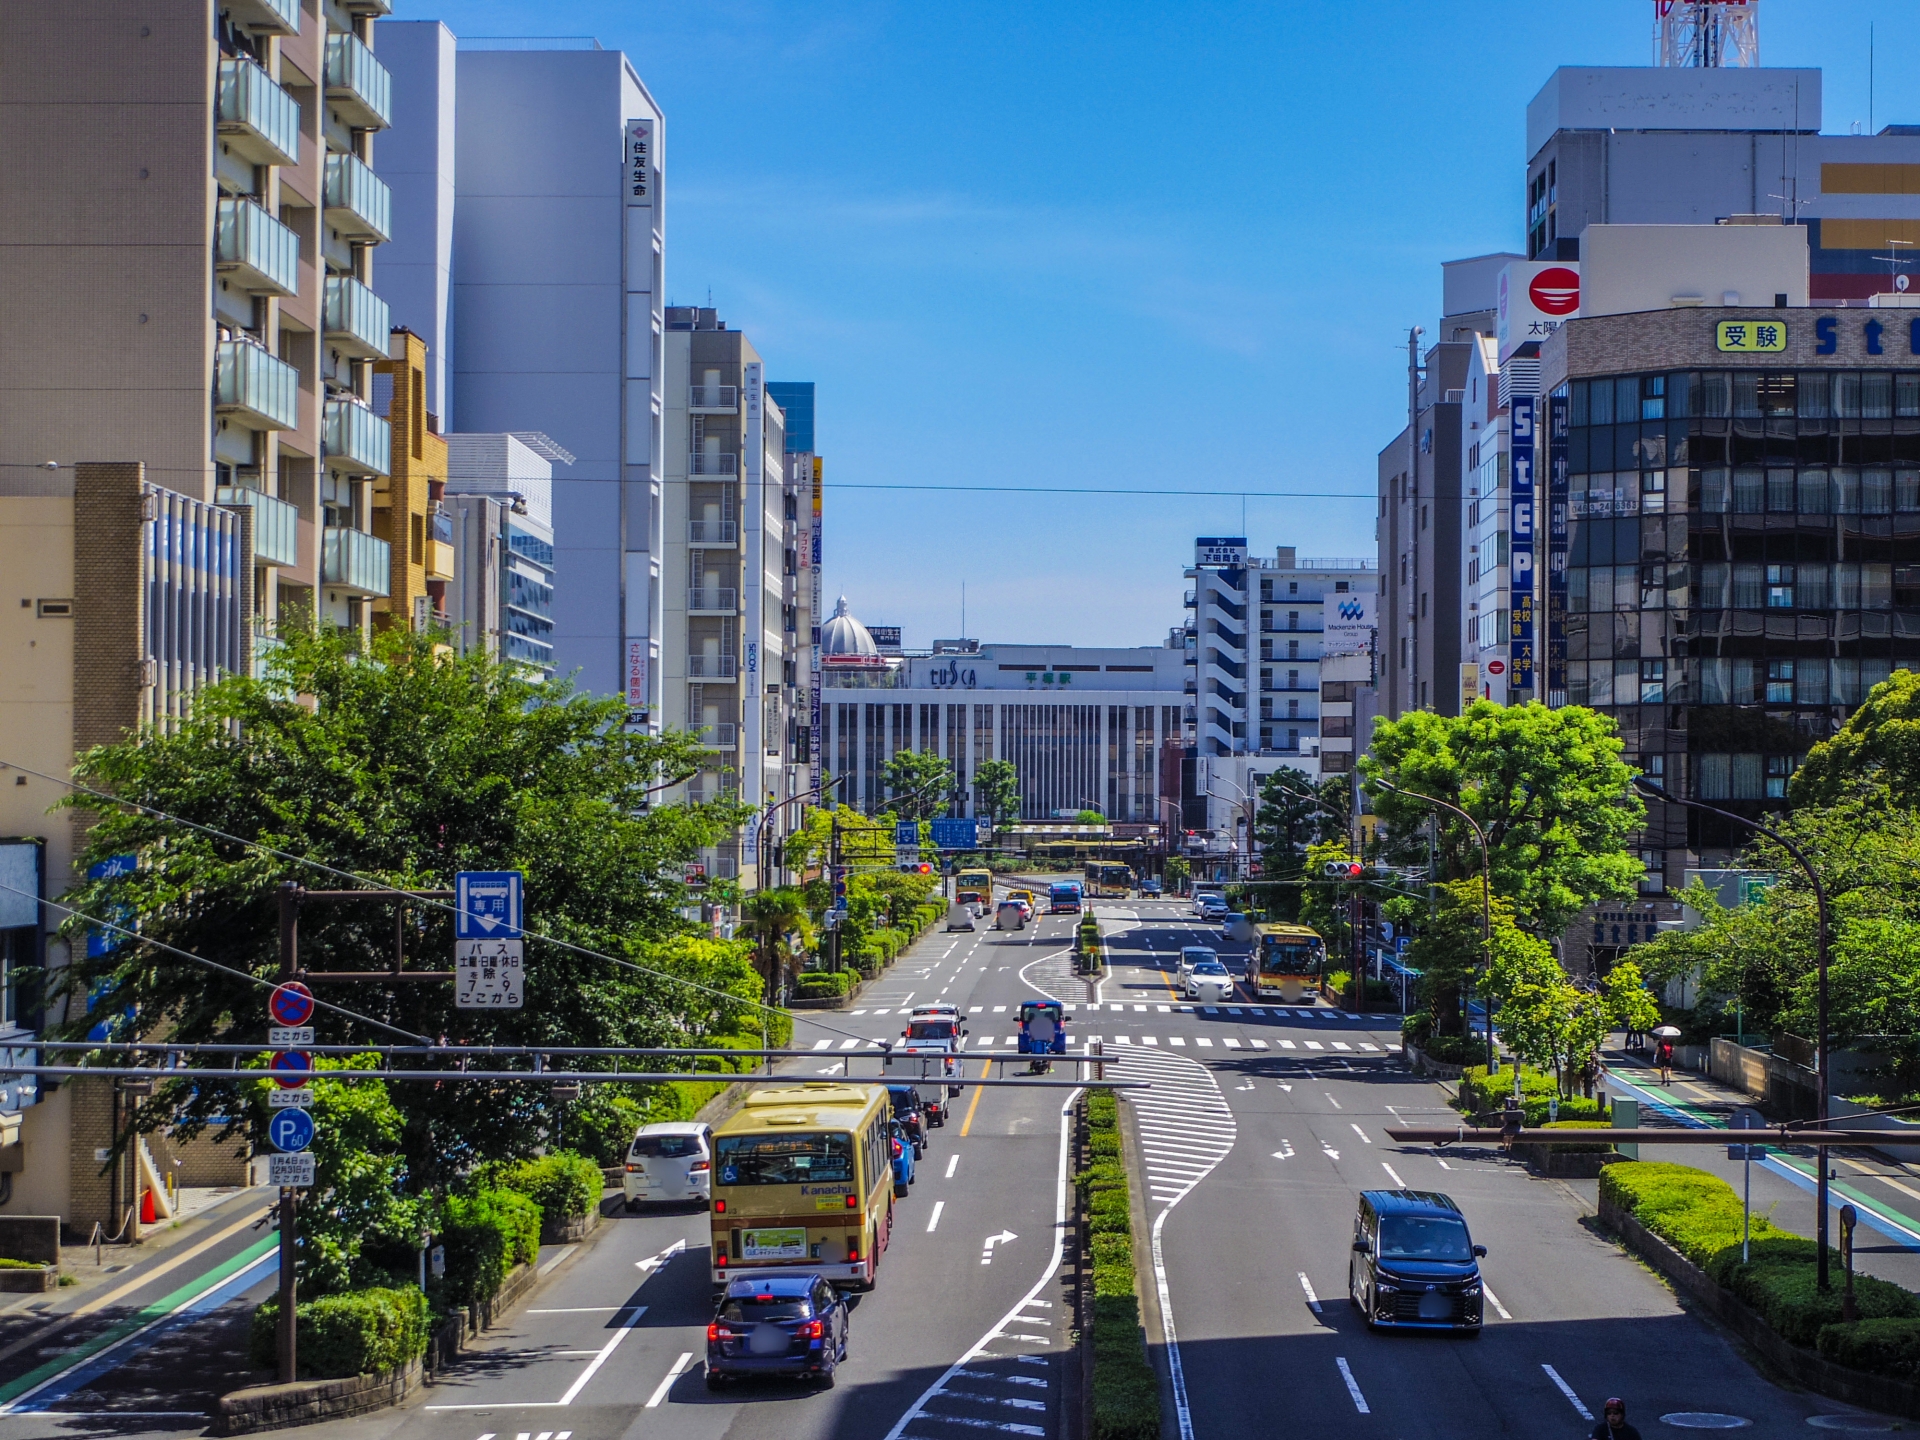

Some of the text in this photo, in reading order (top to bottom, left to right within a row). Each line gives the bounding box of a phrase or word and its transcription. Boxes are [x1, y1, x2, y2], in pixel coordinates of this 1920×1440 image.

[633, 142, 647, 196] 住友生命
[1528, 321, 1567, 335] 太陽
[1725, 325, 1778, 347] 受験
[1203, 554, 1240, 562] 下田商会
[1522, 596, 1531, 622] 高校
[1513, 610, 1521, 636] 受験
[748, 643, 756, 672] SECOM
[1522, 645, 1531, 671] 大学
[630, 643, 640, 699] さなる個別
[1513, 659, 1521, 684] 受験
[1025, 672, 1071, 684] 平塚駅
[631, 714, 643, 722] 3F
[474, 899, 505, 912] 専用
[471, 944, 508, 954] バス
[470, 968, 509, 980] を除く
[460, 993, 519, 1003] ここから
[272, 1032, 310, 1041] ここから
[271, 1094, 310, 1103] ここから
[280, 1120, 296, 1147] P
[273, 1175, 310, 1183] ここから
